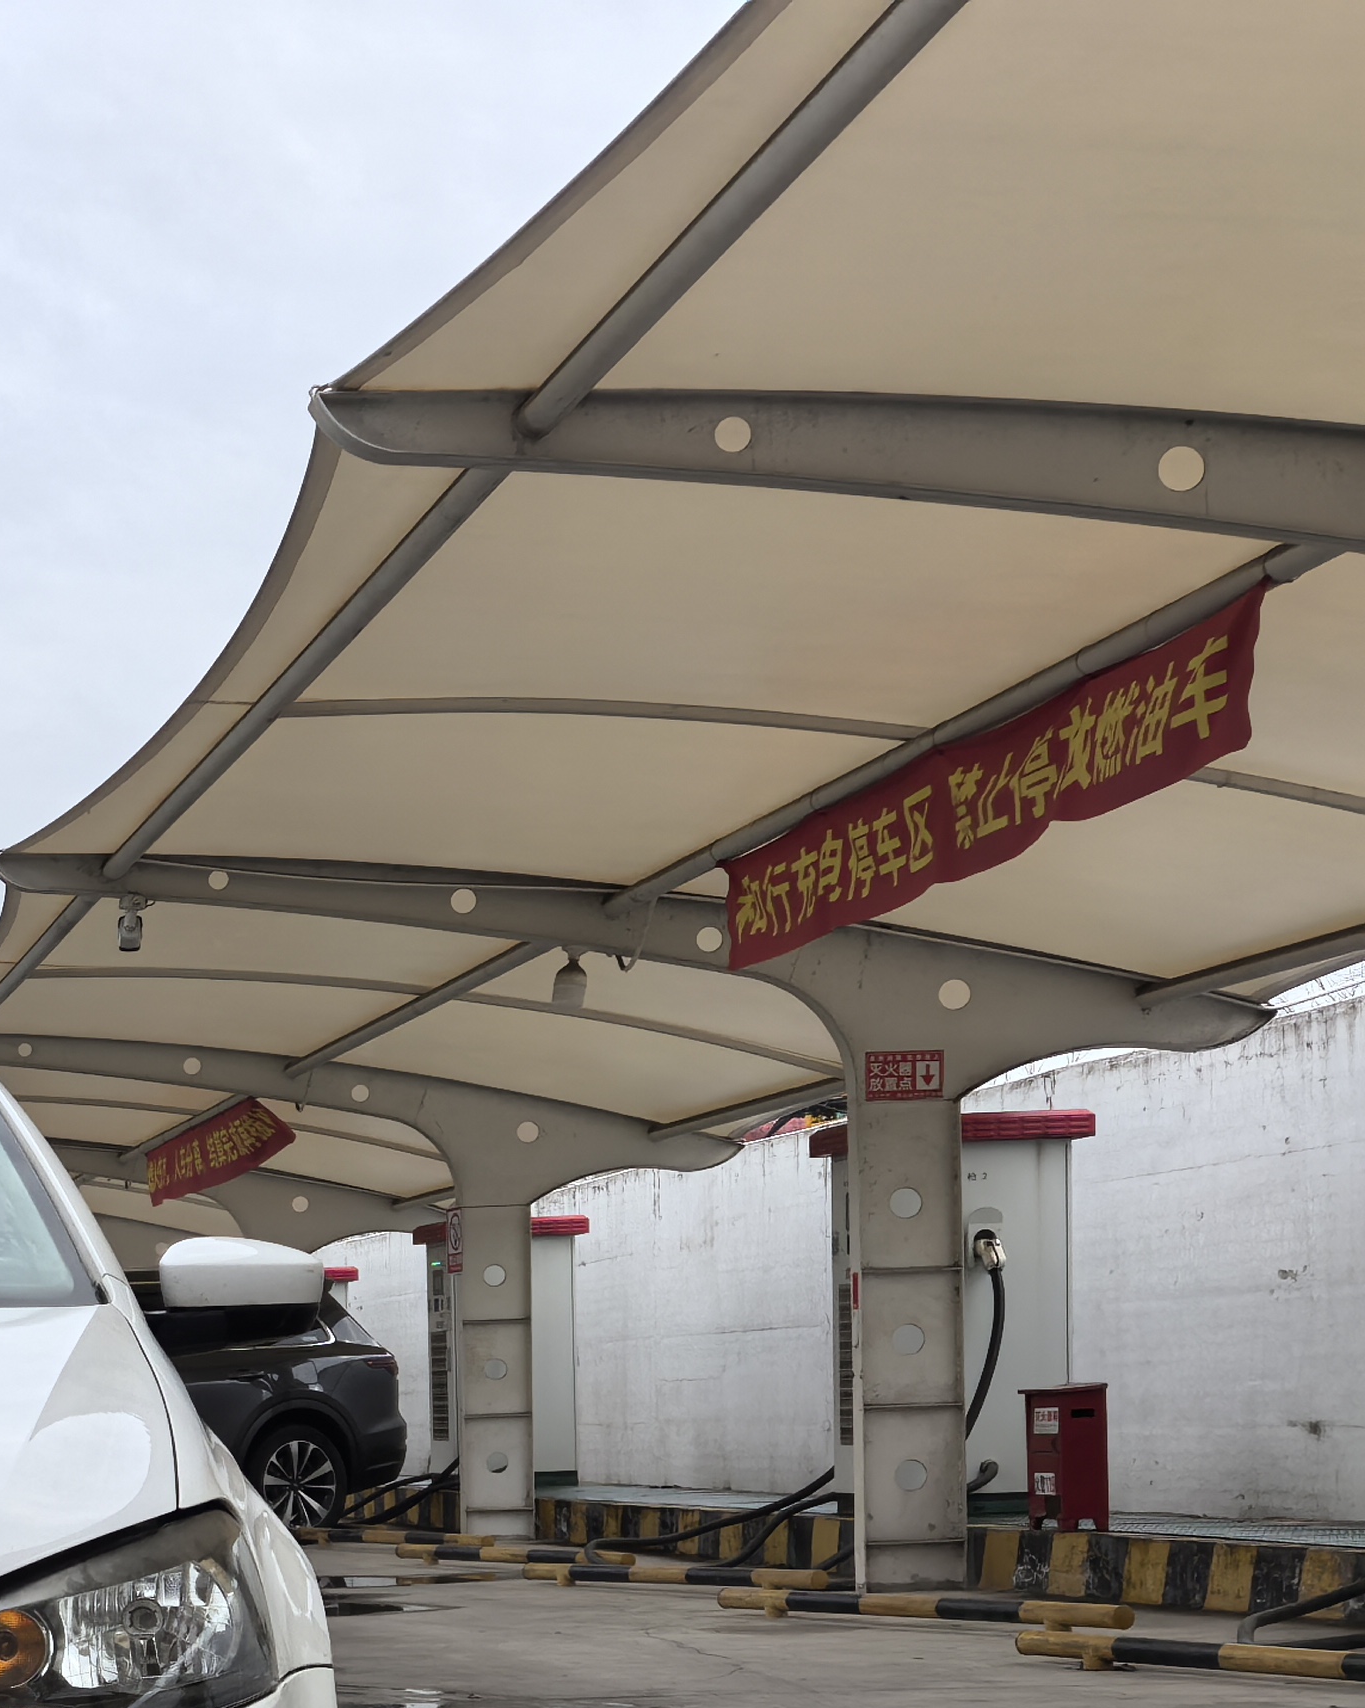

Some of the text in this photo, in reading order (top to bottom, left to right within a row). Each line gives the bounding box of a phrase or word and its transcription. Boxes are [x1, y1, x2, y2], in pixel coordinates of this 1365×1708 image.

[948, 635, 1228, 849] 禁止停放燃油车
